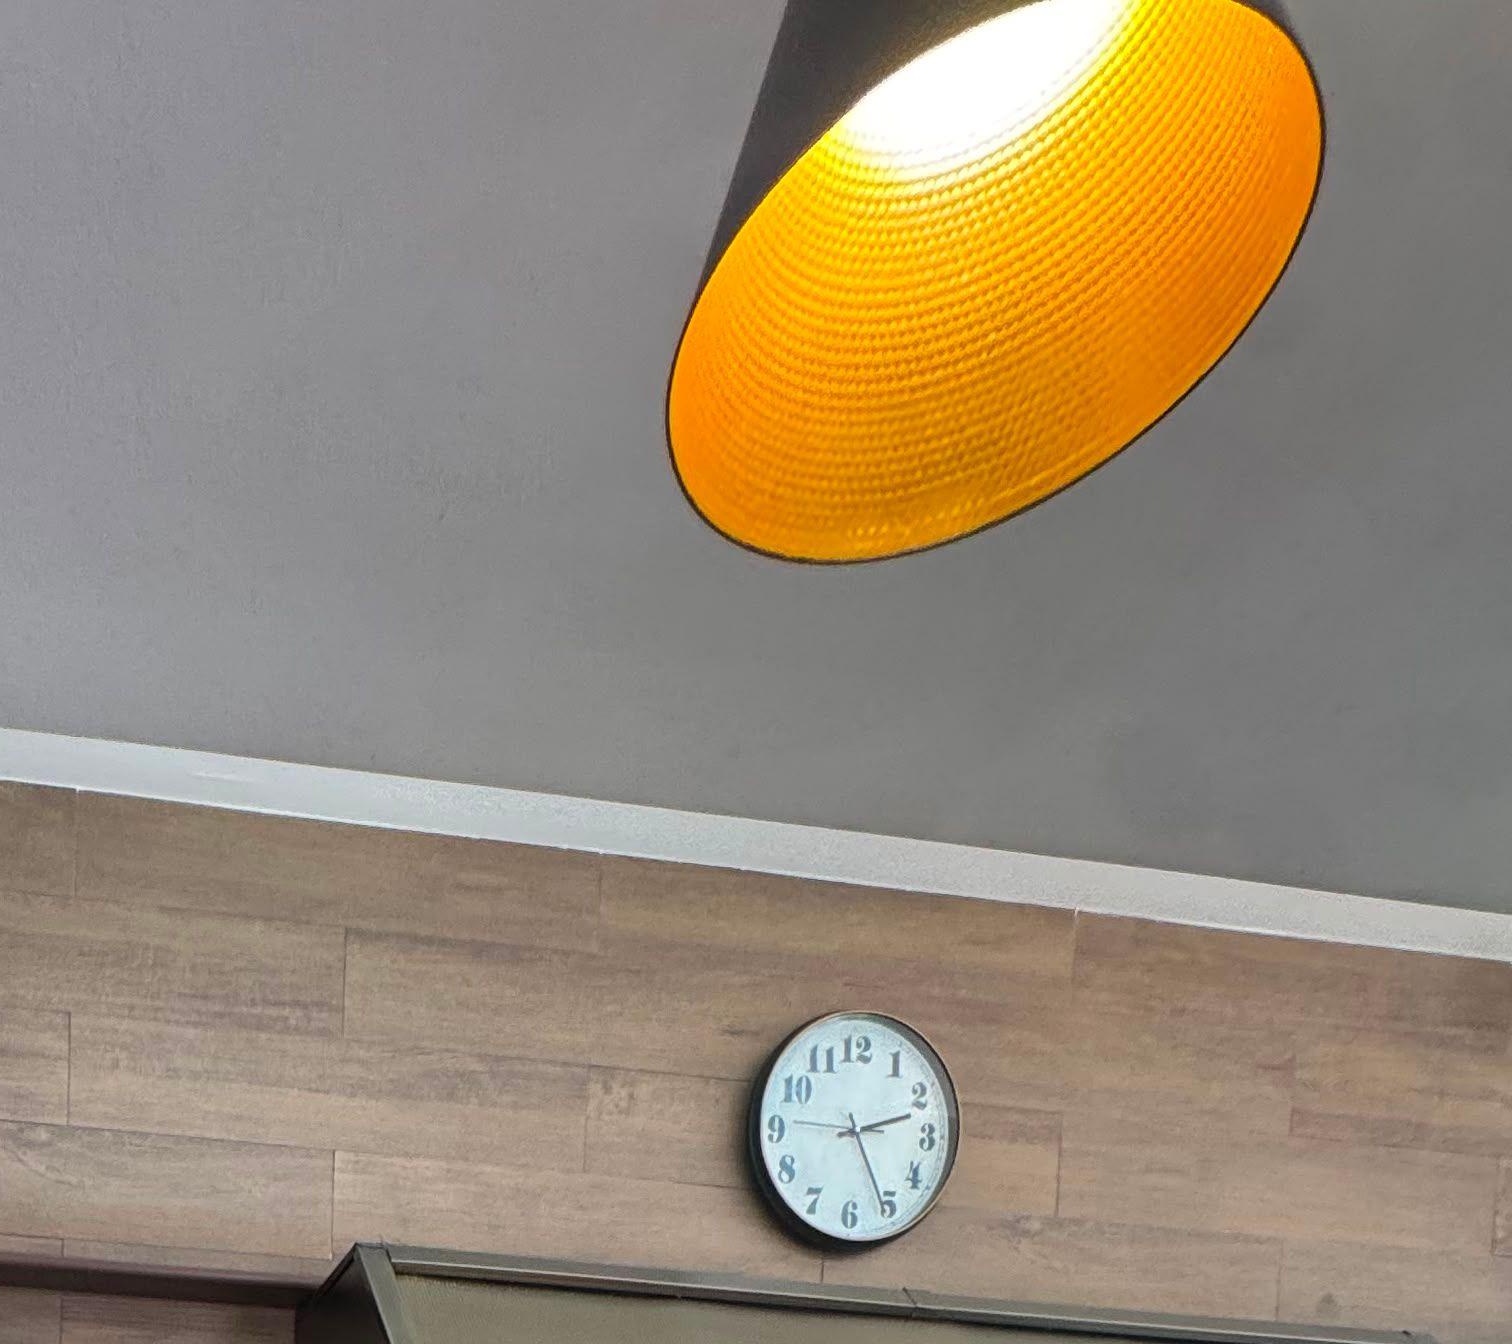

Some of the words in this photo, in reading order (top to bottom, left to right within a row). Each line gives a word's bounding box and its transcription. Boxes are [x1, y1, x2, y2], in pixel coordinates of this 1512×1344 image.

[806, 1045, 837, 1074] 11
[841, 1035, 873, 1065] 12
[888, 1051, 903, 1078] 1
[782, 1074, 812, 1104] 10
[911, 1082, 928, 1110] 2
[767, 1114, 786, 1143] 9
[919, 1123, 936, 1151] 3
[778, 1154, 796, 1184] 8
[905, 1161, 922, 1190] 4
[805, 1187, 824, 1214] 7
[841, 1200, 858, 1229] 6
[880, 1191, 897, 1218] 5
